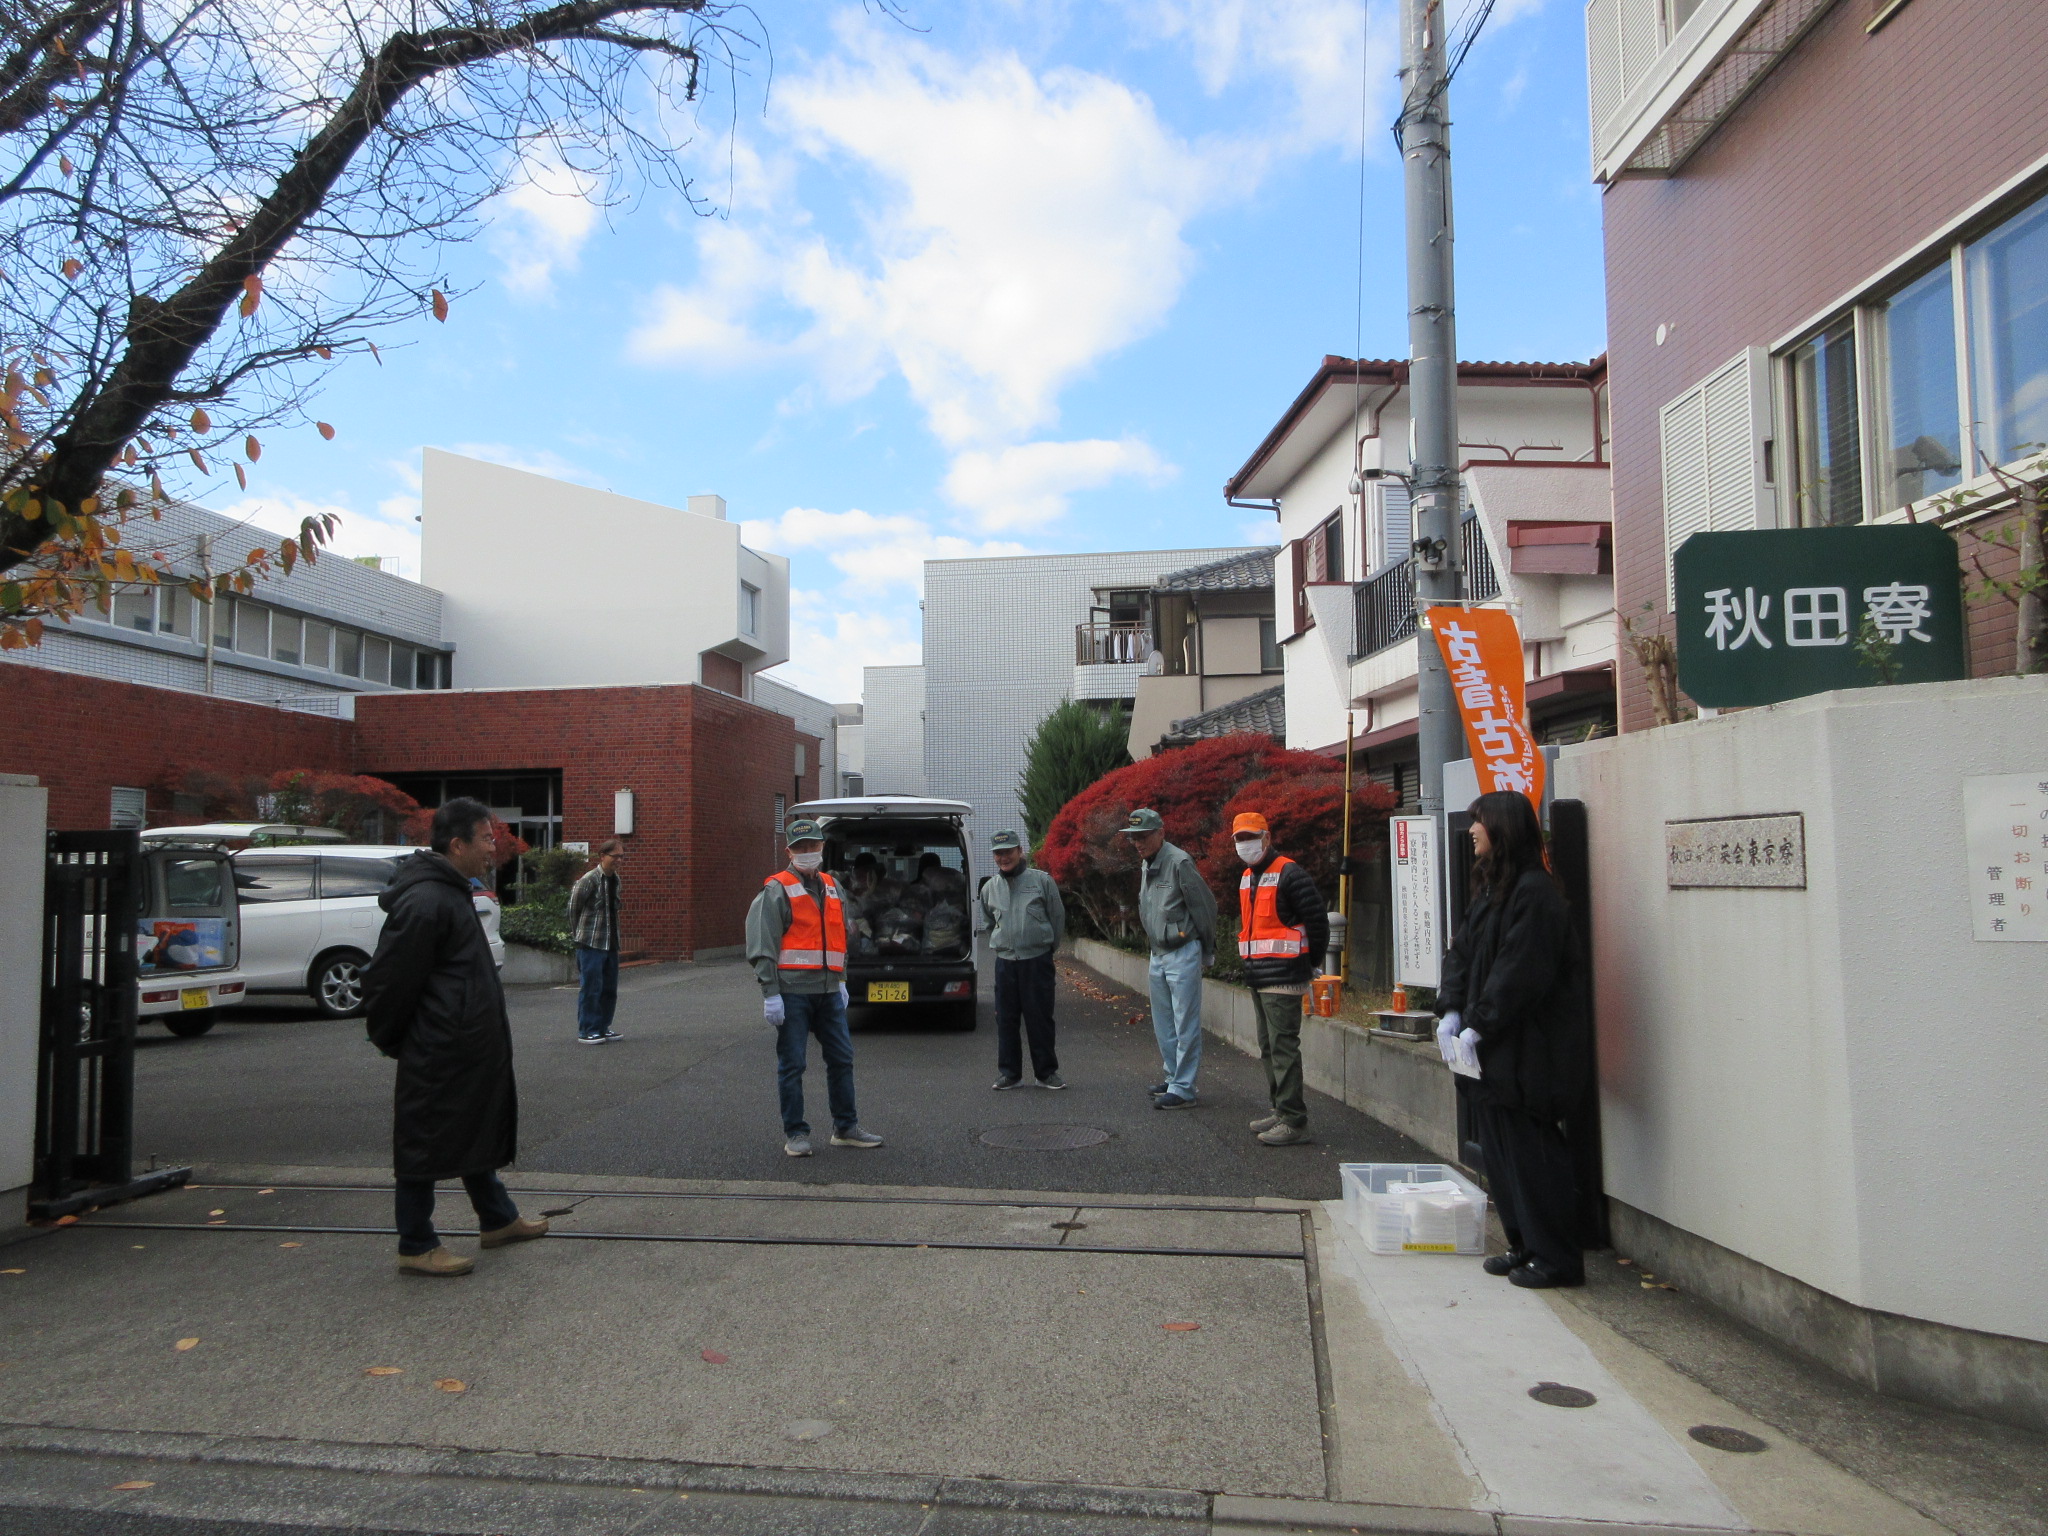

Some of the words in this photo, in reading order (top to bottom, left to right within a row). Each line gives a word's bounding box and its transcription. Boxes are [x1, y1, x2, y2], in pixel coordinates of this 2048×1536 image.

[1703, 581, 1932, 651] 秋田寮
[2010, 802, 2033, 917] 一切お断り
[1986, 866, 2007, 932] 管理者
[877, 989, 907, 1001] 51-26
